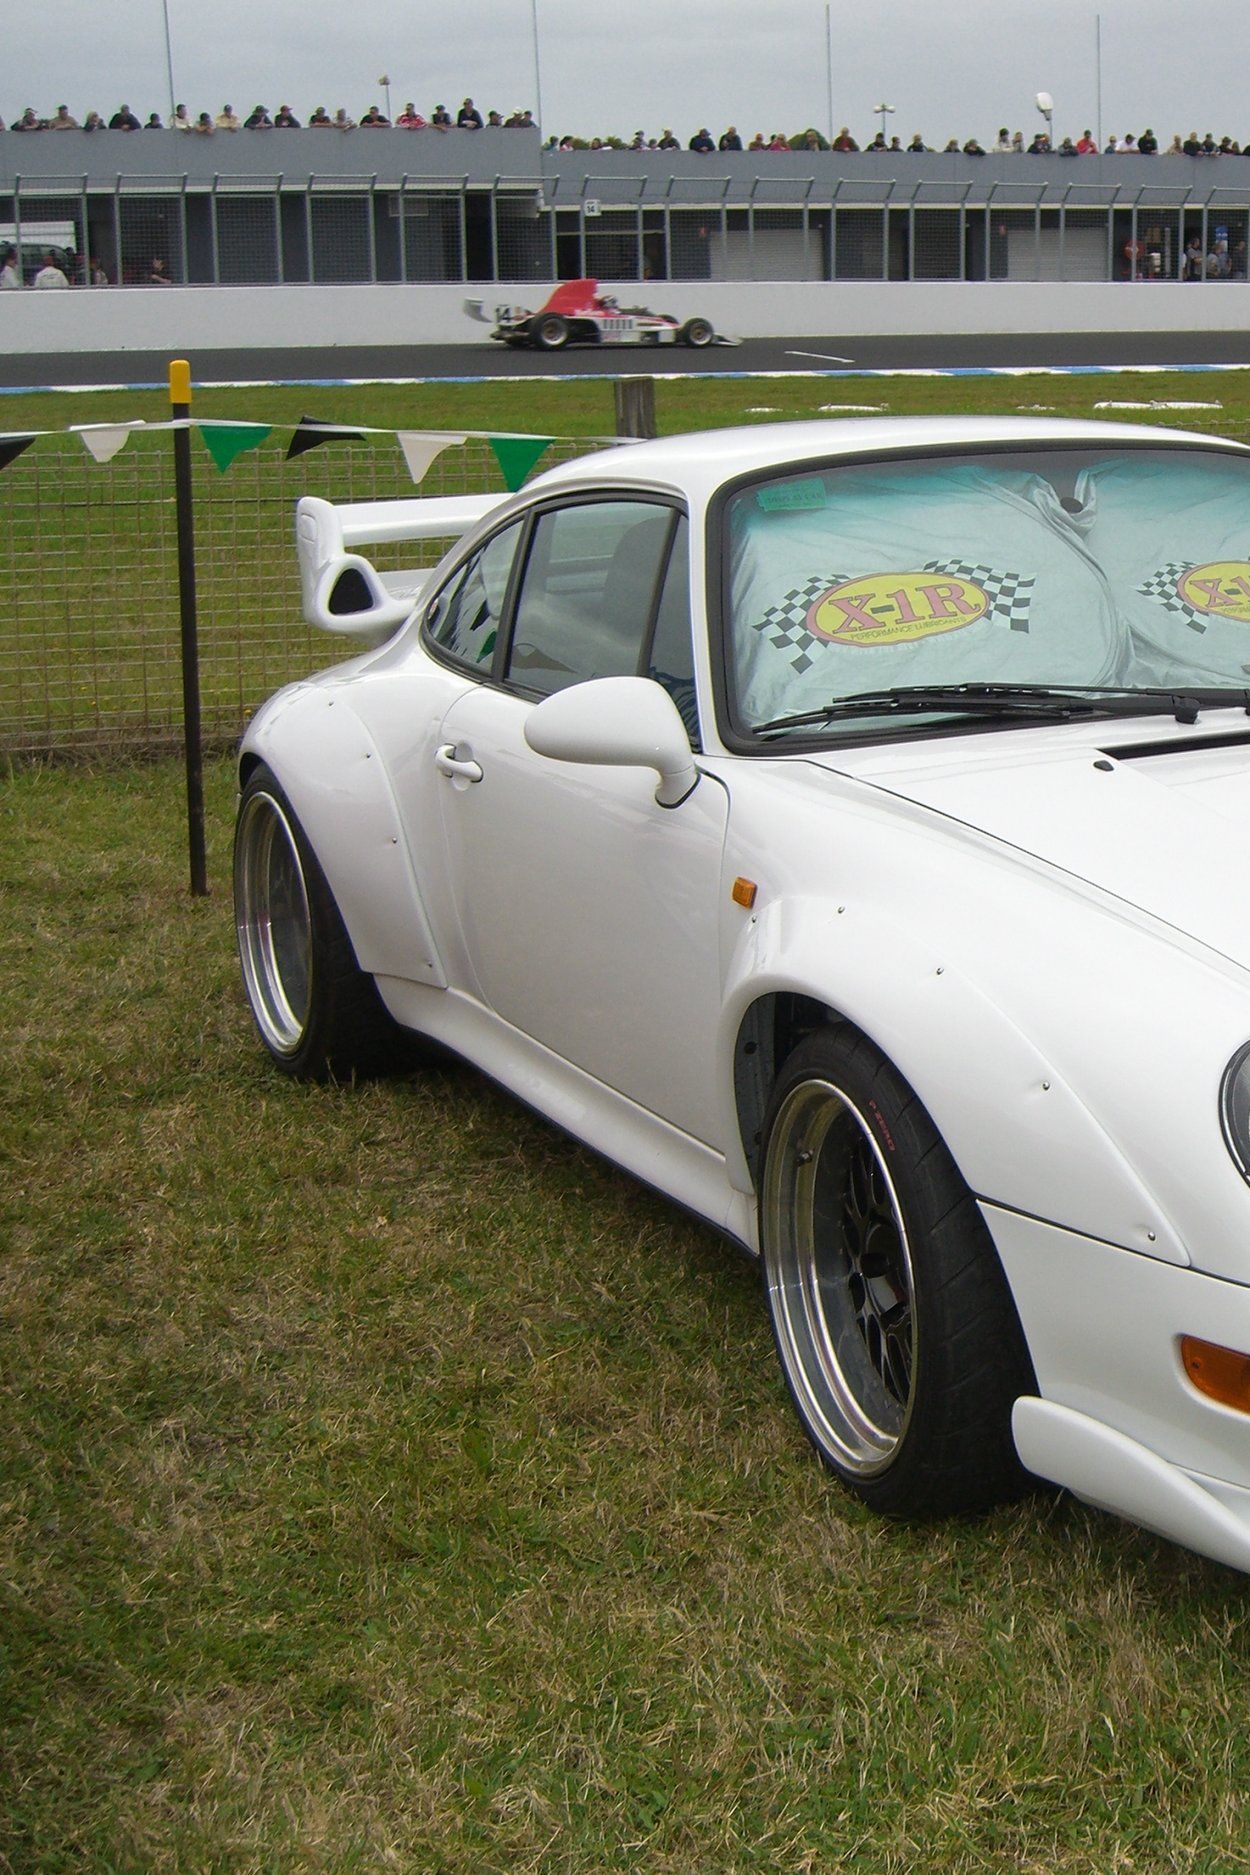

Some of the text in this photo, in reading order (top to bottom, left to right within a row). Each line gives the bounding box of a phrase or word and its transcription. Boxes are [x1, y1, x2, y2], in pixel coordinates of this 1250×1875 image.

[495, 305, 510, 323] 14
[828, 583, 981, 634] X-1R
[850, 622, 914, 641] PERFORMANCE
